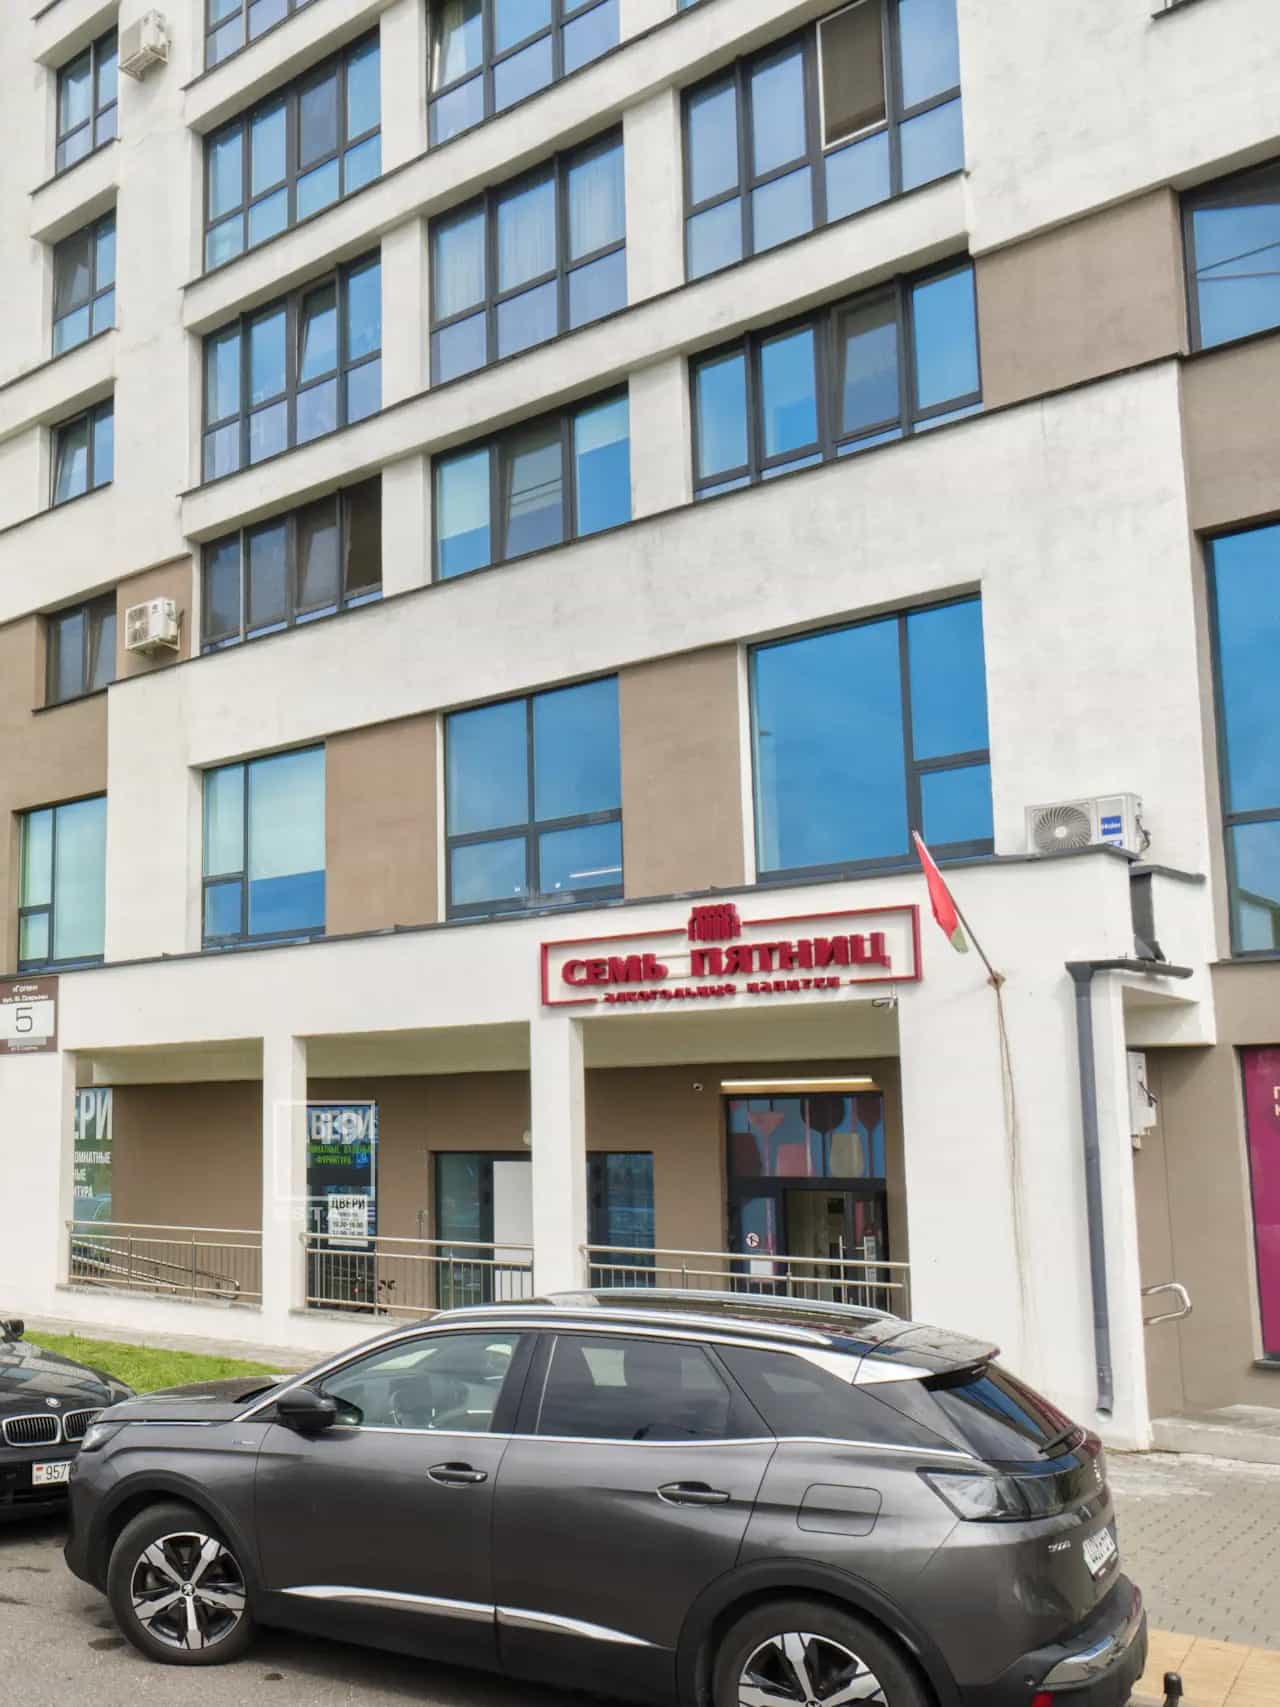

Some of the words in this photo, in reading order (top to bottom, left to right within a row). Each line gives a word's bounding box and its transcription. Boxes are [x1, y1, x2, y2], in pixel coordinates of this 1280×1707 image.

[561, 953, 669, 987] СЕМЬ
[689, 931, 891, 978] ПЯТНИЦ
[603, 983, 737, 1004] алкогольные
[746, 975, 841, 994] напитки
[15, 1006, 33, 1032] 5
[331, 1198, 366, 1210] ДВЕРИ
